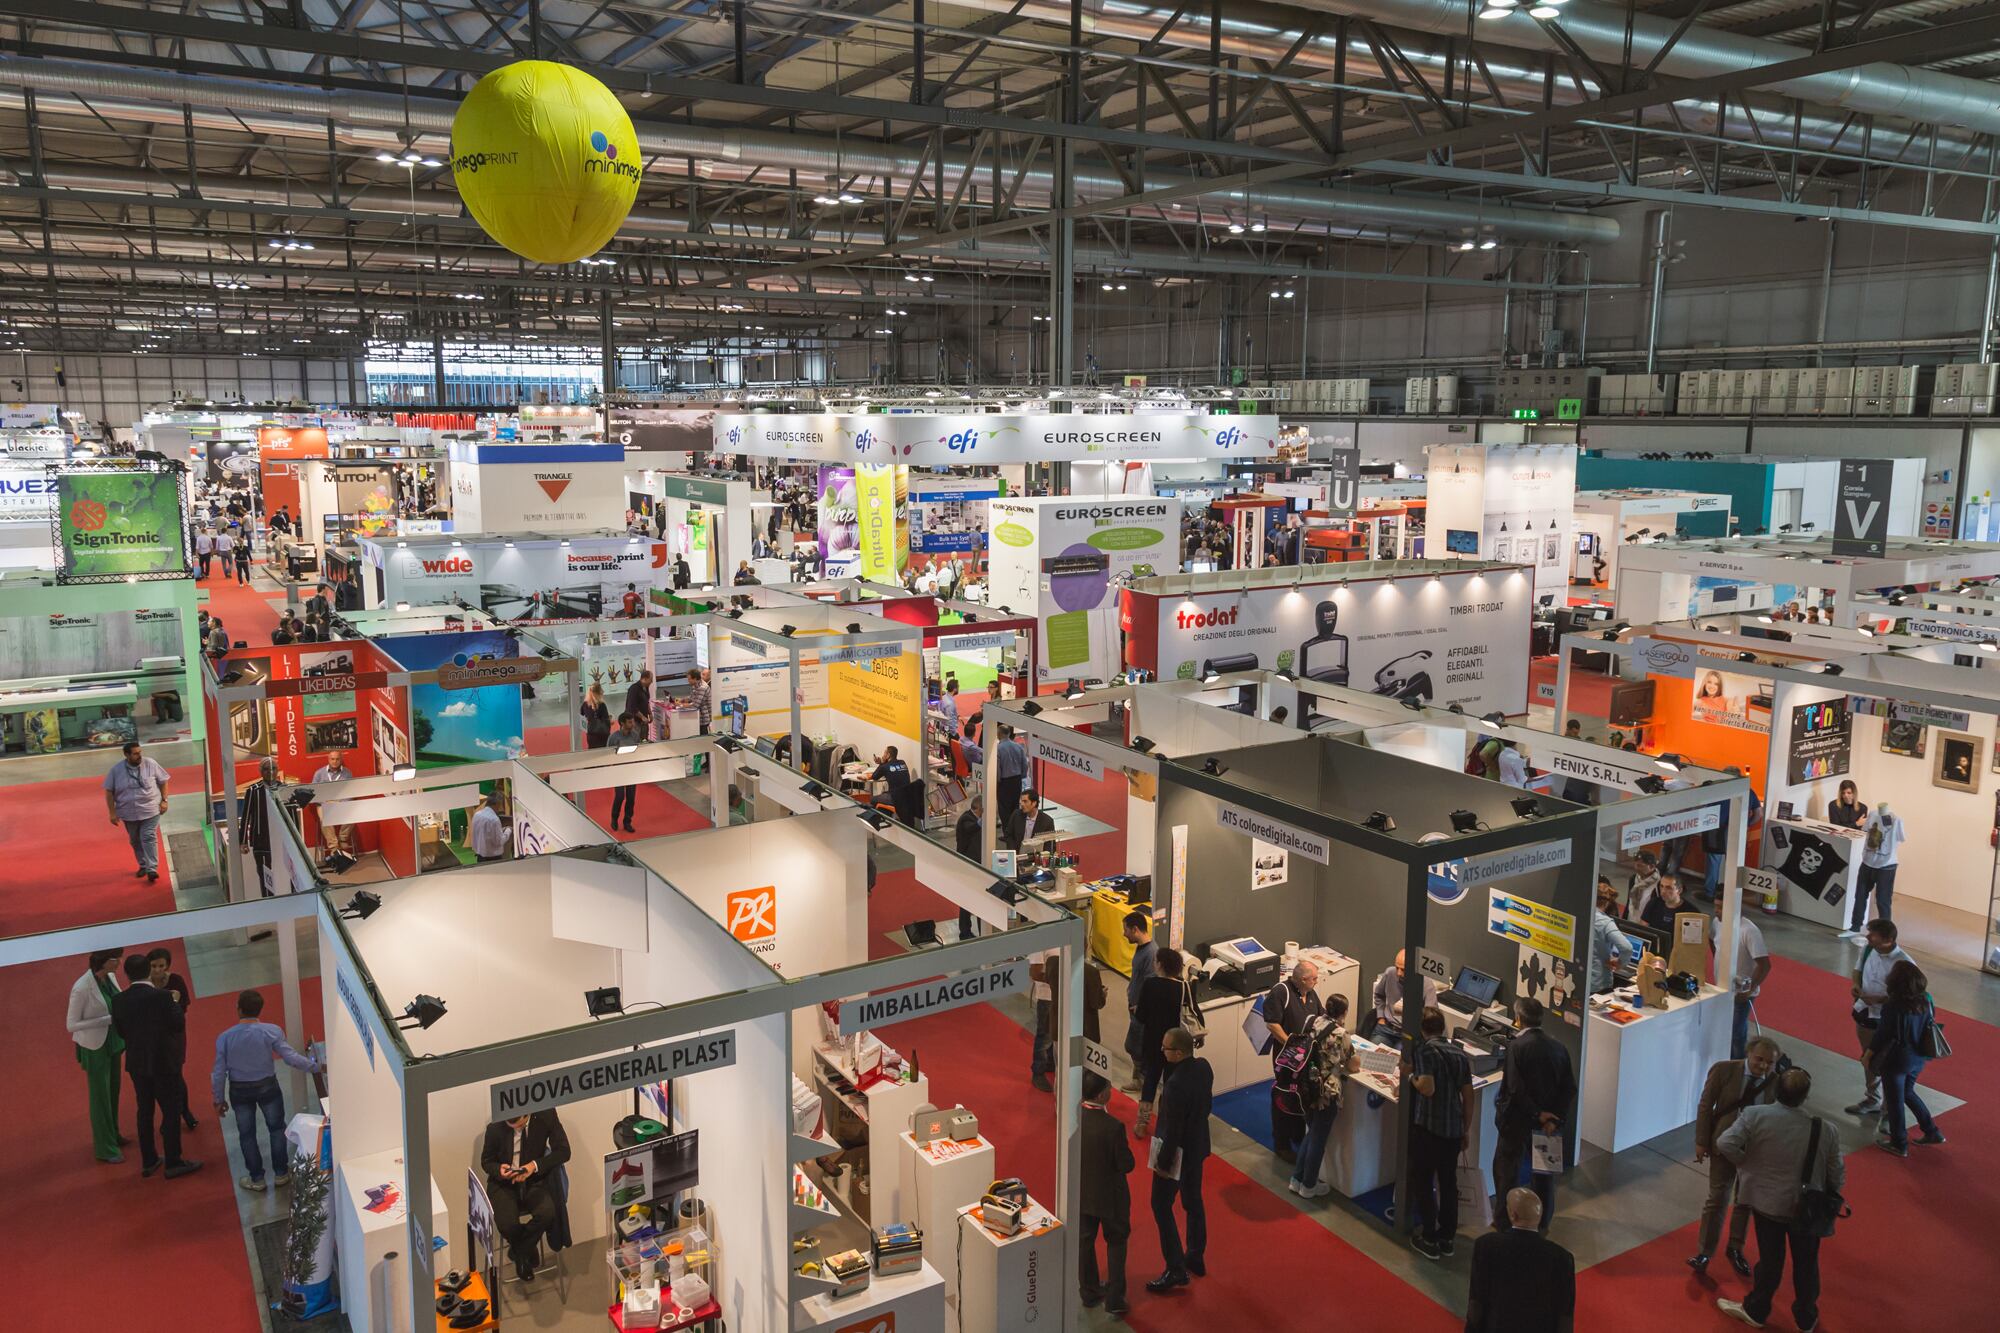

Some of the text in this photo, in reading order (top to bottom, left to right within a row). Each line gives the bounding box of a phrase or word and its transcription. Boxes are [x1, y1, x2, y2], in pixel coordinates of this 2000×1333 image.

[729, 425, 740, 446] efi
[766, 430, 824, 443] EUROSCREEN
[856, 428, 872, 454] efi
[948, 428, 978, 454] efi
[1044, 432, 1161, 444] EUROSCREEN
[1216, 426, 1241, 448] efi
[1342, 455, 1347, 467] 1
[324, 473, 377, 482] MUTOH
[534, 472, 573, 480] TRIANGLE
[1858, 465, 1867, 482] 1
[1334, 480, 1354, 509] U
[992, 504, 1034, 513] EUROSCREEN
[1055, 505, 1167, 520] EUROSCREEN
[1845, 500, 1880, 539] V
[616, 553, 644, 563] print
[568, 563, 578, 572] is
[601, 562, 622, 571] life.
[828, 566, 845, 578] efi
[1176, 605, 1238, 630] trodat
[1450, 602, 1504, 616] TIMBRI TRODAT
[1193, 626, 1277, 642] CREAZIONE DEGLI ORIGINALI
[1909, 622, 1998, 640] TECNOTRONICA S.a.s.
[884, 646, 899, 655] SRL
[954, 636, 1002, 648] LITPOLSTAR
[1447, 645, 1489, 658] AFFIDABILI.
[1638, 650, 1690, 664] LASERGOLD
[872, 658, 898, 680] felice
[1446, 658, 1484, 671] ELEGANTI.
[298, 676, 356, 694] LIKEIDEAS
[844, 674, 860, 686] nostro
[1446, 671, 1485, 684] ORIGINALI.
[1541, 686, 1554, 696] V19
[1900, 704, 1924, 716] TEXTILE
[1925, 706, 1952, 719] PIGMENT
[1952, 711, 1963, 722] INK
[1039, 742, 1094, 774] DALTEX S.A.S.
[1554, 757, 1627, 785] FENIX S.R.L.
[1222, 808, 1324, 858] ATS coloredigitale.com
[1644, 818, 1700, 838] PIPPONLINE
[1462, 848, 1566, 884] ATS coloredigitale.com
[1749, 873, 1773, 890] Z22
[730, 892, 774, 935] PK
[1421, 956, 1444, 976] Z26
[858, 968, 1015, 1024] IMBALLAGGI PK
[1086, 1044, 1108, 1070] Z28
[500, 1039, 731, 1111] NUOVA GENERAL PLAST
[1027, 1250, 1039, 1304] GlueDots
